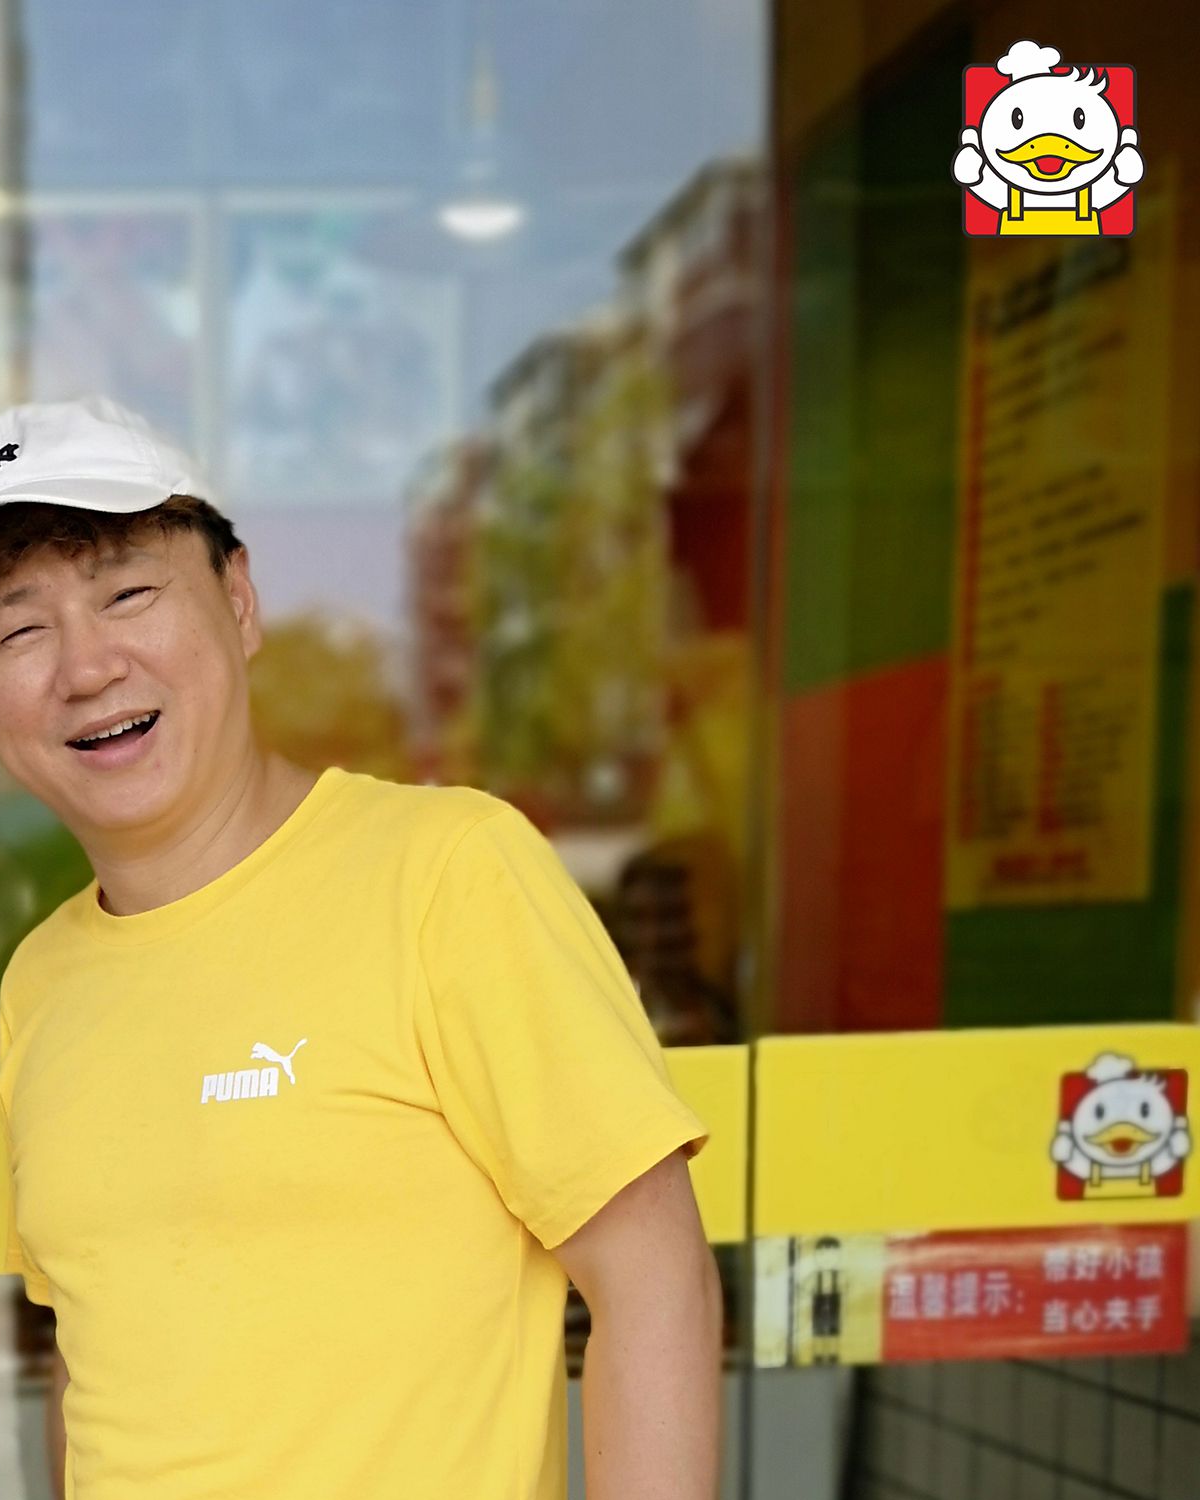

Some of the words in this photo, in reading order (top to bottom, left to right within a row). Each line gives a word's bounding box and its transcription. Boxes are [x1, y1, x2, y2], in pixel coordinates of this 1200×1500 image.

[200, 1066, 279, 1105] PUMA
[1043, 1244, 1164, 1282] 带好小孩
[1042, 1296, 1161, 1334] 当心夹手
